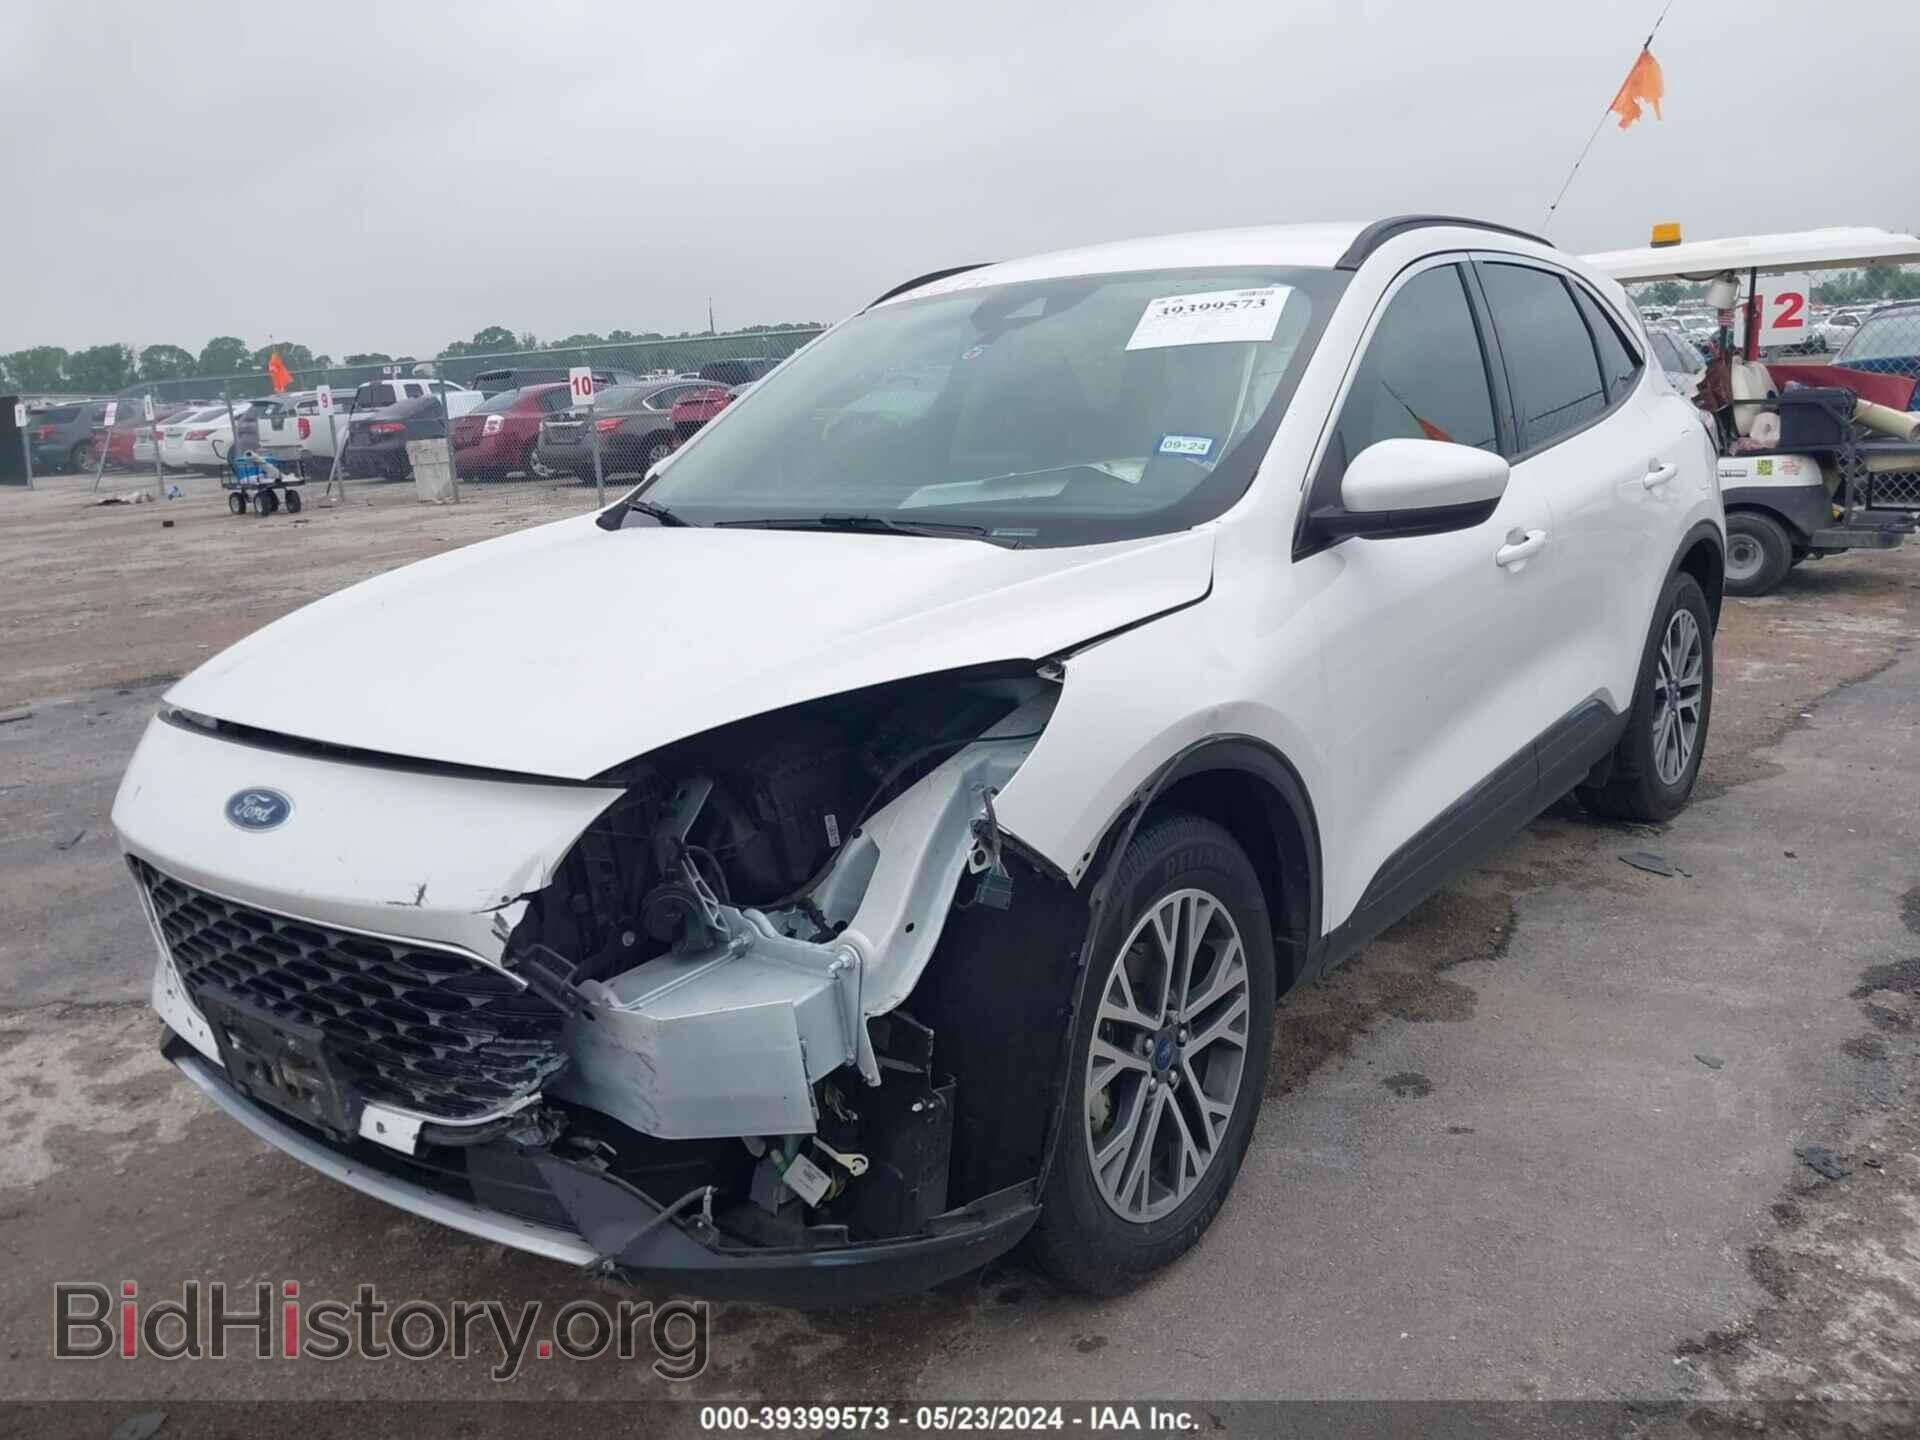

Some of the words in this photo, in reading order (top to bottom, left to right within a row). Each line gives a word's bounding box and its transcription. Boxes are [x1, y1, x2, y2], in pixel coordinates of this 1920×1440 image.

[1159, 298, 1267, 315] 39399573
[572, 376, 592, 396] 10
[320, 392, 329, 409] 9
[1163, 440, 1207, 451] 09-24
[234, 793, 277, 823] Ford
